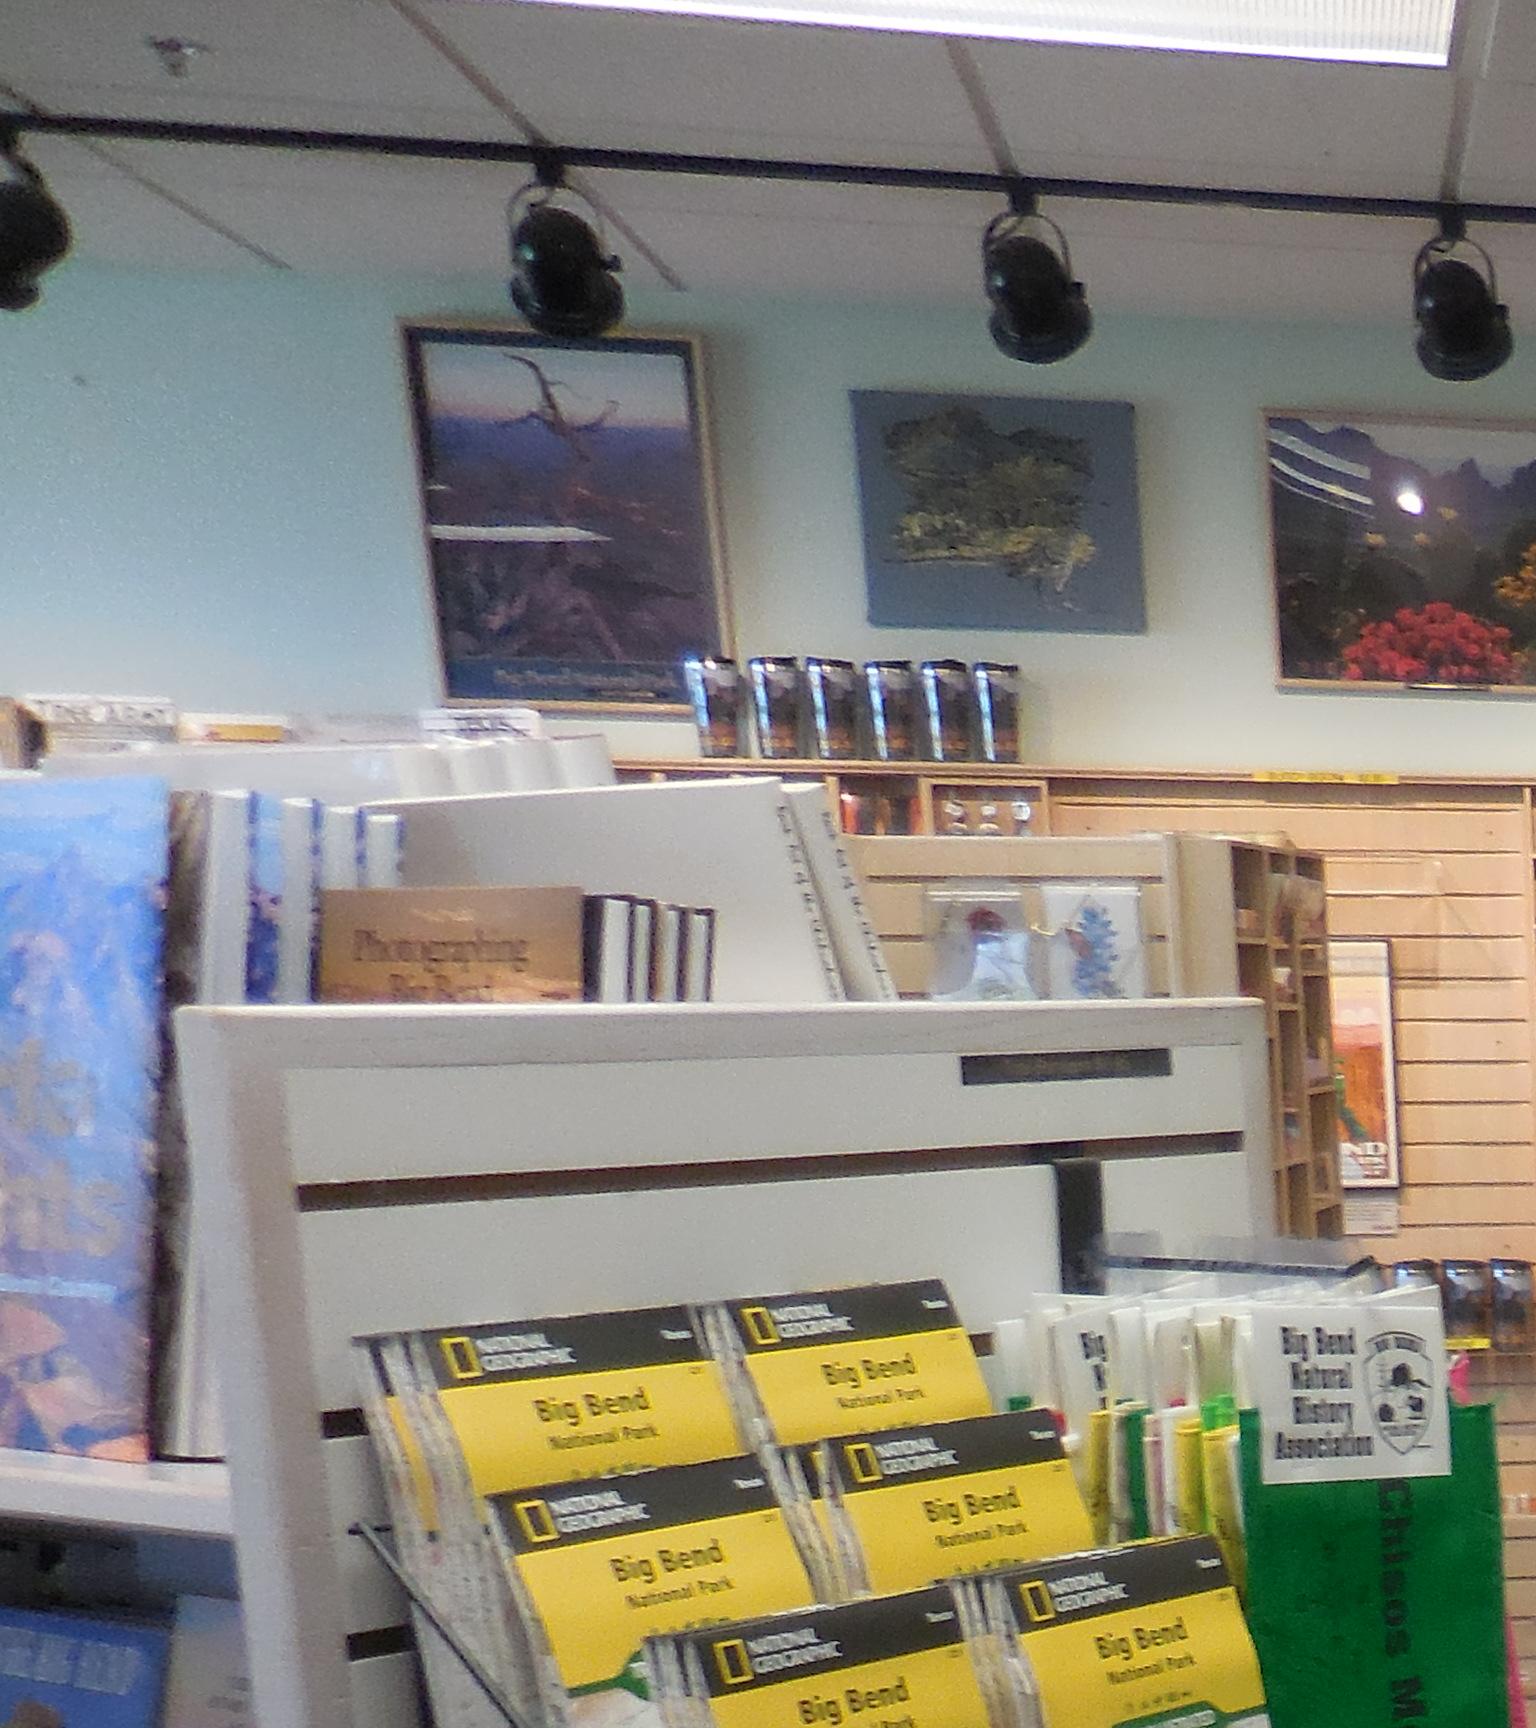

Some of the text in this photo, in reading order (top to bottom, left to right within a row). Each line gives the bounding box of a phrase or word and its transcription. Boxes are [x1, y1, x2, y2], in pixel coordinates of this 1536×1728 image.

[352, 928, 530, 974] Photographing
[1279, 1326, 1310, 1362] Big
[1314, 1326, 1357, 1356] Bend
[820, 1353, 916, 1387] Big Bend
[1288, 1361, 1353, 1391] Natural
[532, 1386, 652, 1427] Big Bend
[835, 1387, 927, 1411] National Park
[1291, 1395, 1355, 1432] History
[547, 1424, 660, 1450] National Park
[1273, 1431, 1375, 1462] Association
[920, 1486, 1022, 1523] Big Bend
[933, 1521, 1029, 1548] National Park
[609, 1539, 725, 1584] Big Bend
[1378, 1477, 1413, 1660] Chisos
[624, 1576, 735, 1610] National Park
[1092, 1616, 1189, 1661] Big Bend
[1105, 1655, 1197, 1685] National Park
[797, 1676, 910, 1727] Big Bend
